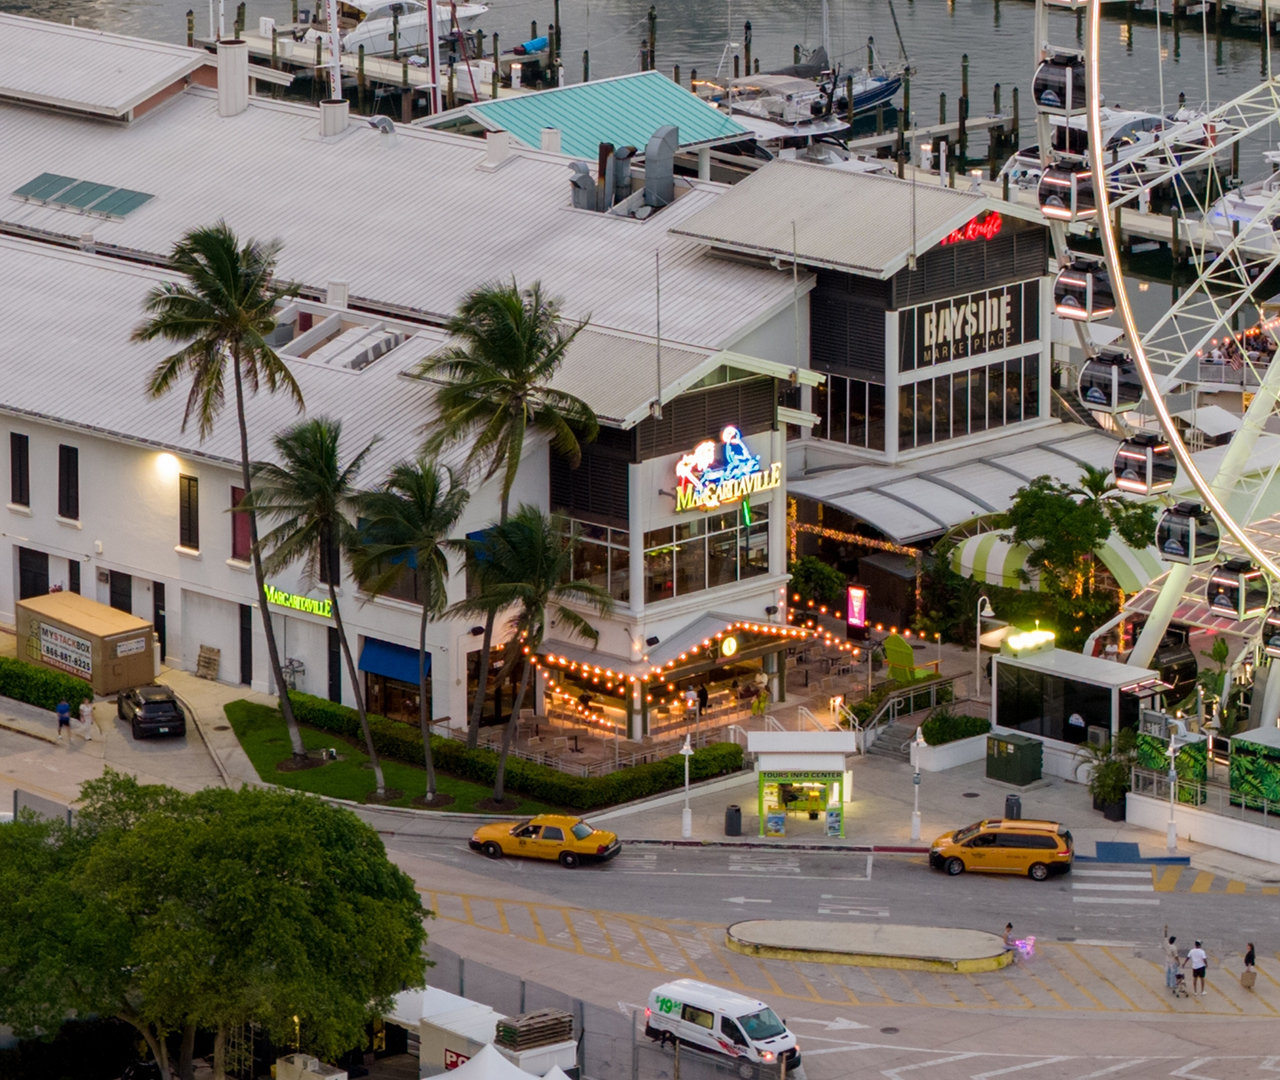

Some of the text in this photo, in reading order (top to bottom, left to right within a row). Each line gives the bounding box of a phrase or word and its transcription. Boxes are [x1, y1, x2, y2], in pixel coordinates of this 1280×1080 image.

[923, 294, 1011, 347] BAYSIDE
[264, 583, 332, 618] MARGARITAVILLE
[41, 627, 90, 654] MYSTACKBOX
